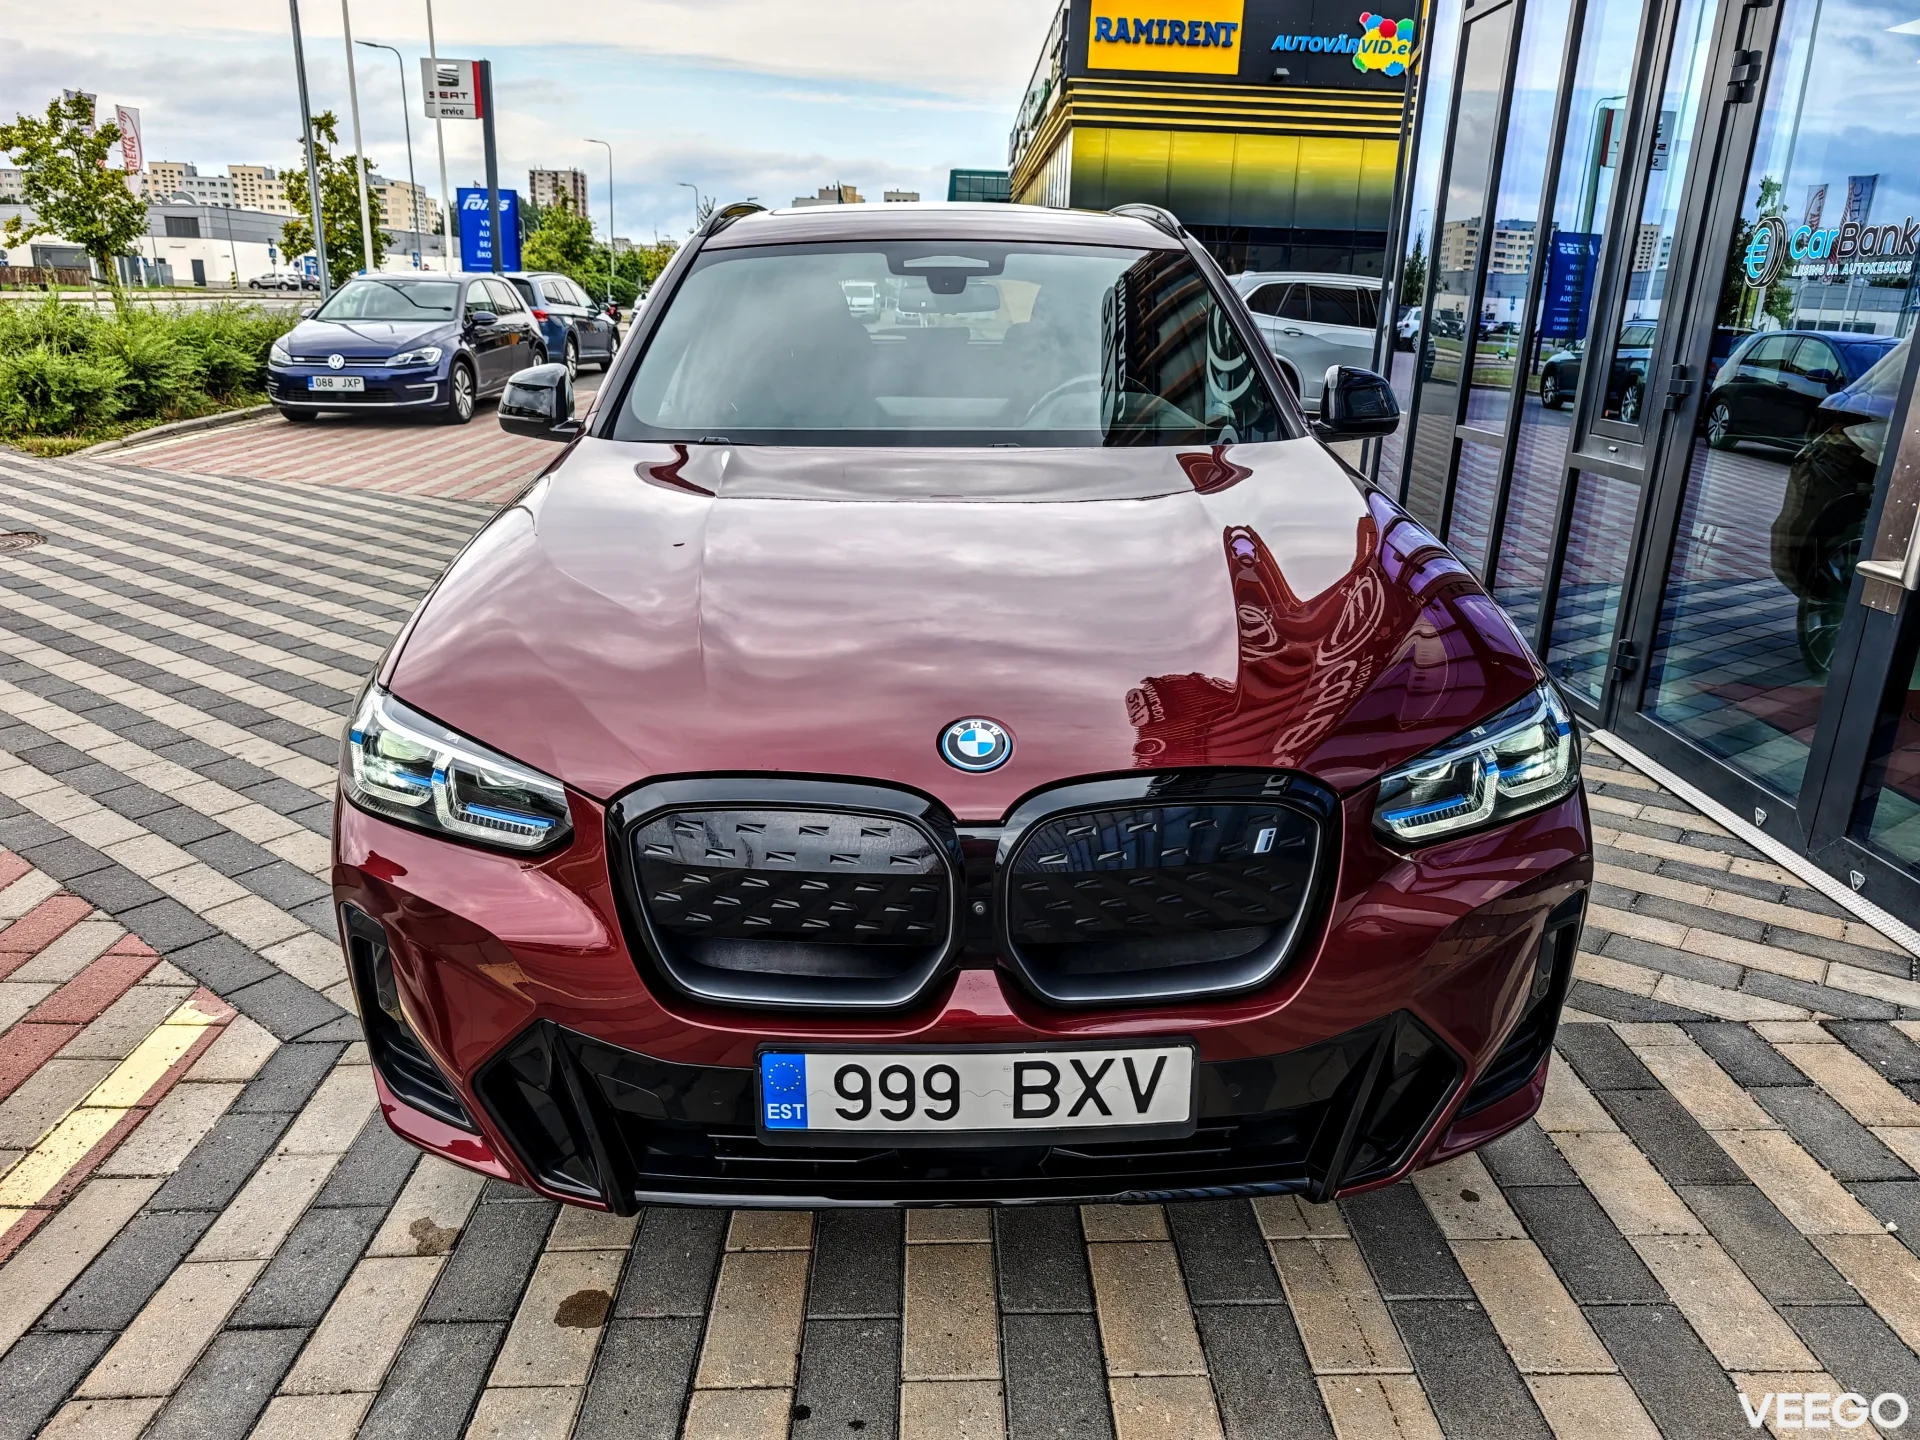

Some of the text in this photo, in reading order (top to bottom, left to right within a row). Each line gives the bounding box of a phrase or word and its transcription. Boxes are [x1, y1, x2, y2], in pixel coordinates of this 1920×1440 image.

[1095, 16, 1238, 47] RAMIRENT
[440, 107, 465, 117] ervice
[1790, 216, 1920, 260] CarBank
[1792, 260, 1912, 277] LIISING JA AUTOKESKUS
[315, 378, 361, 388] 088 JXP
[951, 721, 1002, 736] BMW
[833, 1055, 1168, 1122] 999 BXV
[767, 1103, 805, 1120] EST
